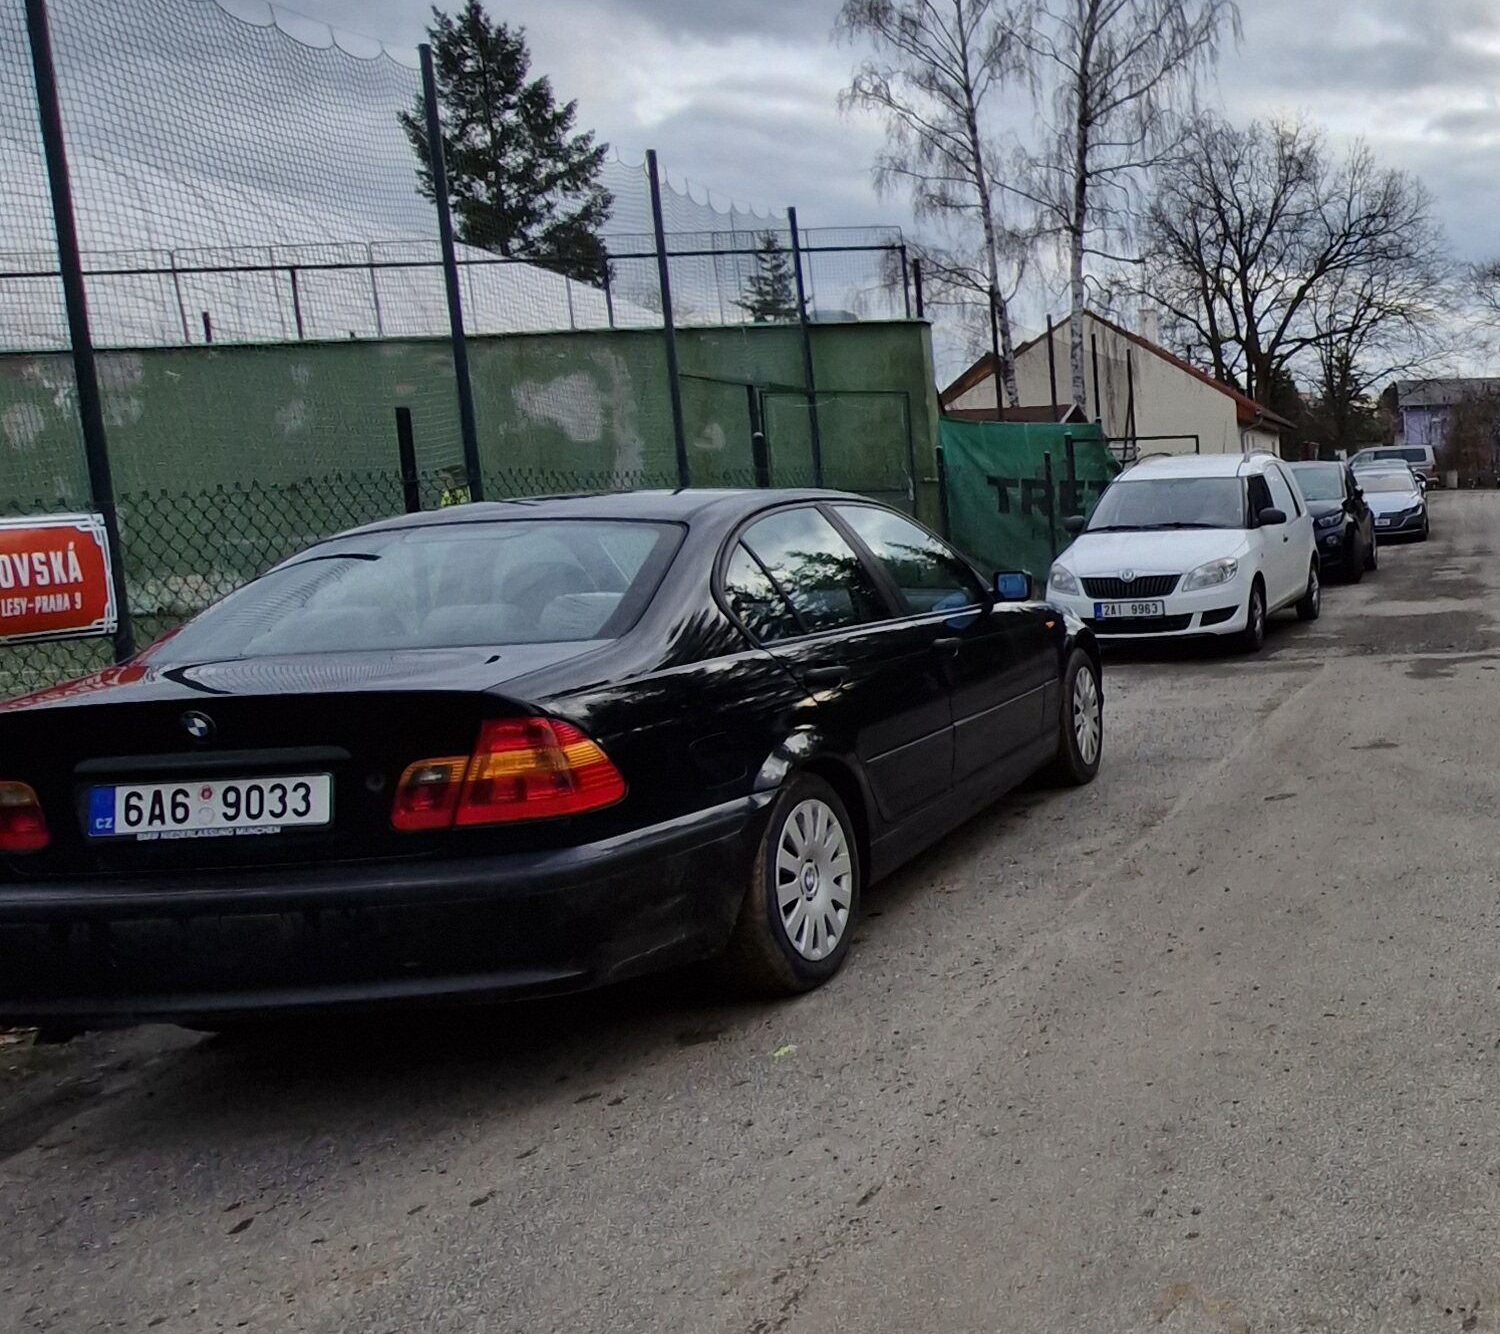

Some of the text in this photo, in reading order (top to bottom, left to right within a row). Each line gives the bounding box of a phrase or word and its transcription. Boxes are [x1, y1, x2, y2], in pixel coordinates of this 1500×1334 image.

[75, 592, 82, 610] 9
[1131, 603, 1158, 615] 9963
[95, 782, 311, 829] CZ 6A6 9033
